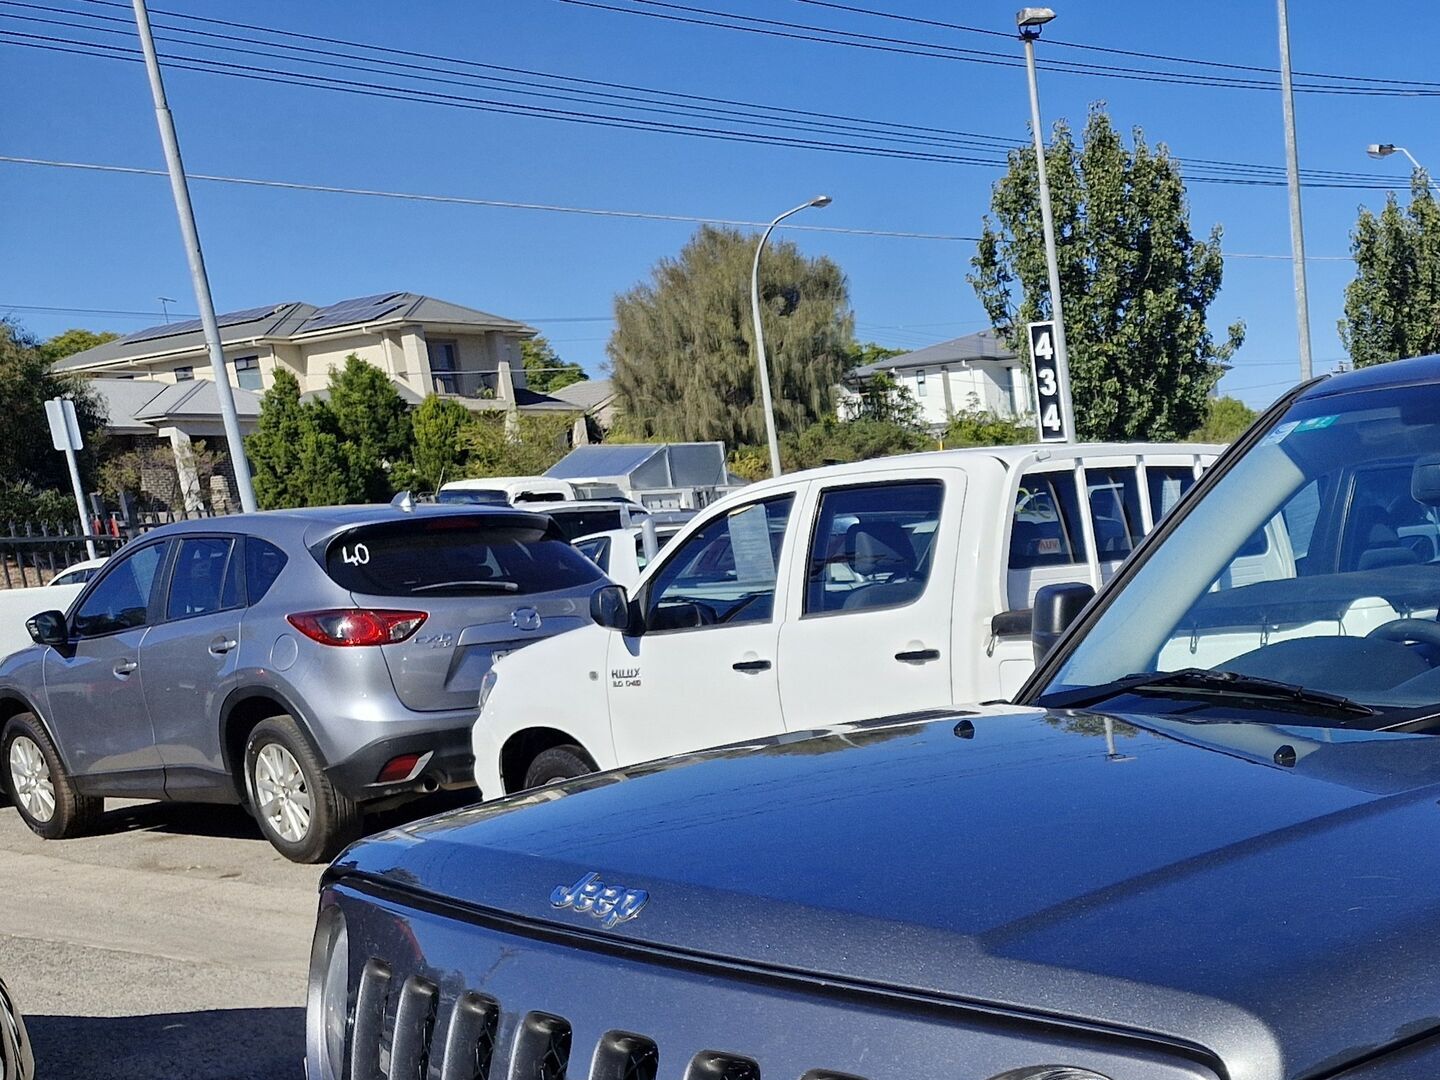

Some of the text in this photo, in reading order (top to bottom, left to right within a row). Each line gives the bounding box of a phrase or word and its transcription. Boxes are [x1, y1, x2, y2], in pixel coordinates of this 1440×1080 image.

[1035, 332, 1061, 431] 434
[342, 543, 370, 566] 40
[611, 668, 641, 679] HILUX
[550, 871, 650, 930] Jeep
